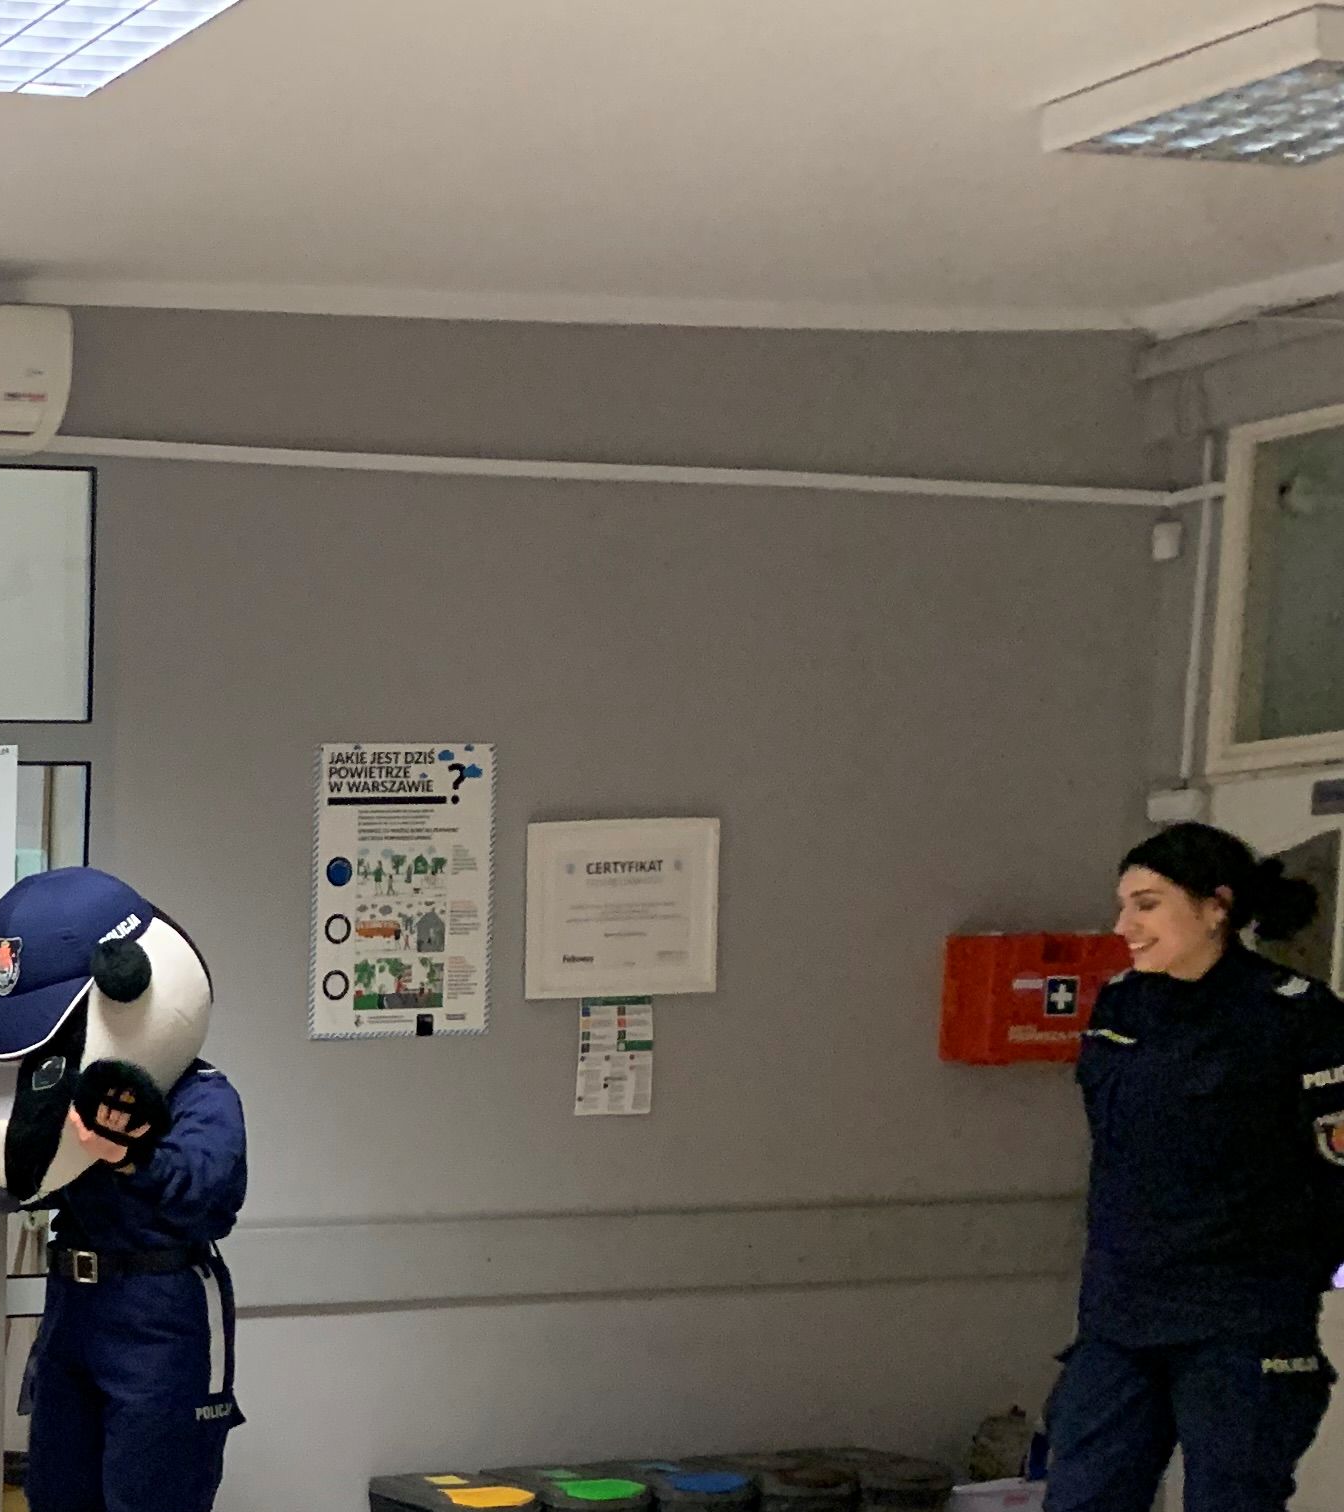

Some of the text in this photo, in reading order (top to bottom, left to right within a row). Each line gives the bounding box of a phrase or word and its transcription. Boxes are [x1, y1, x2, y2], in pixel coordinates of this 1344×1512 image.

[328, 748, 436, 765] JAKIE JEST DZIŚ
[328, 765, 412, 779] POWIETRZE
[328, 780, 434, 793] W WARSZAWIE
[585, 859, 664, 875] CERTYFIKAT
